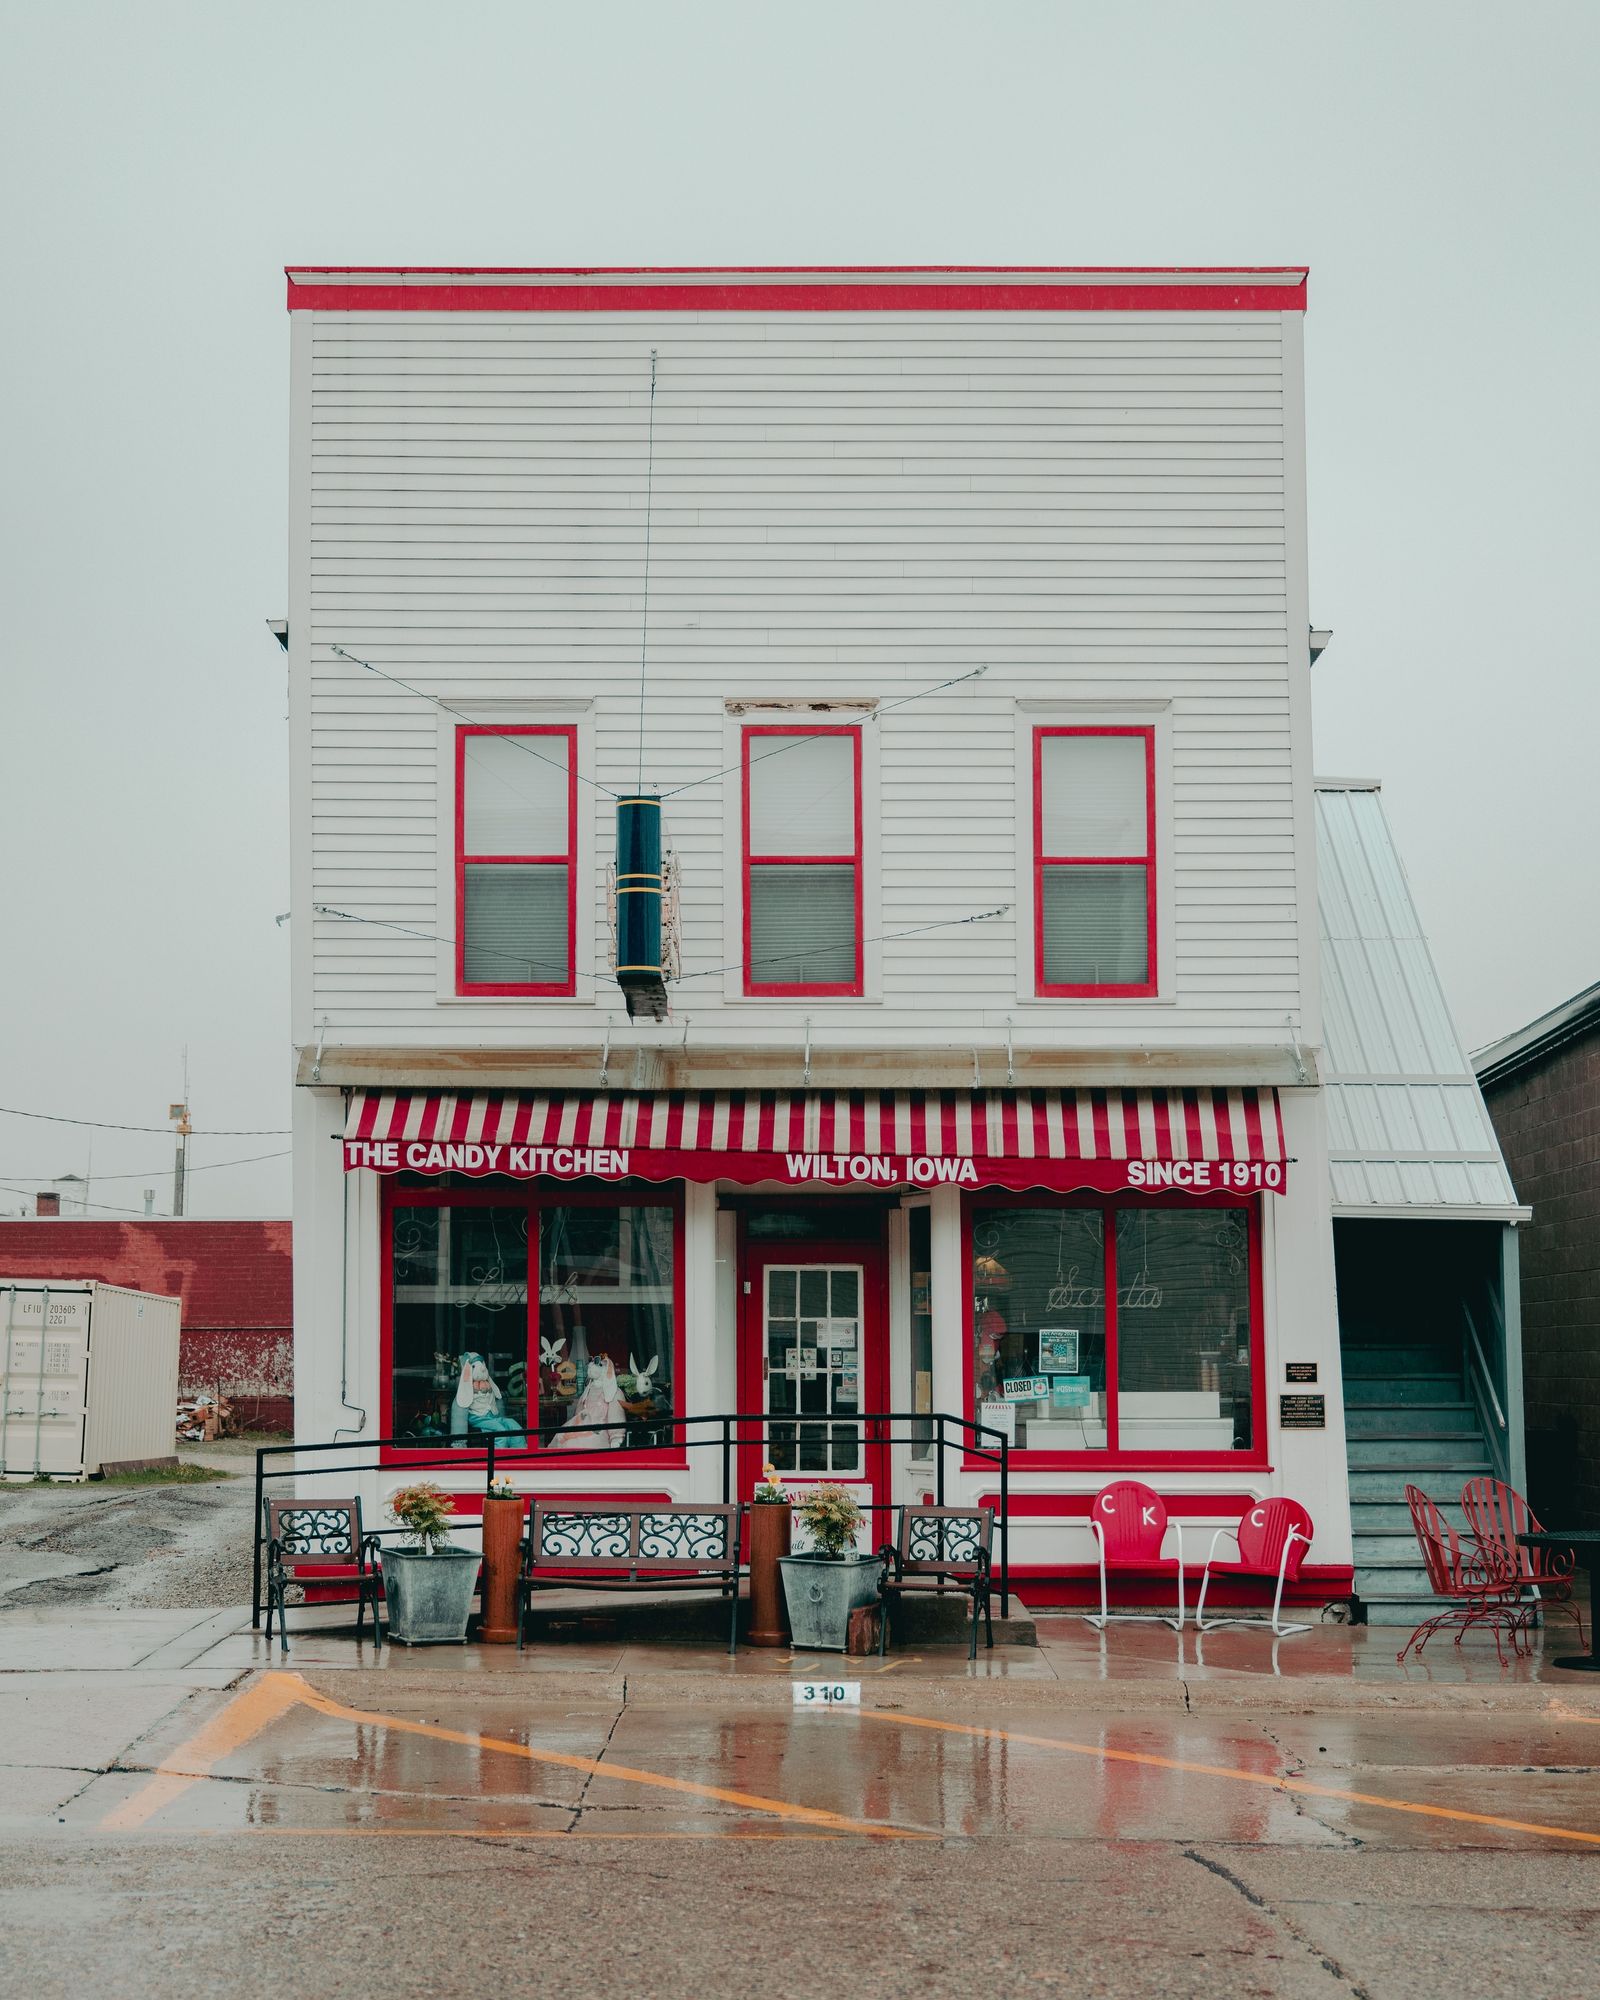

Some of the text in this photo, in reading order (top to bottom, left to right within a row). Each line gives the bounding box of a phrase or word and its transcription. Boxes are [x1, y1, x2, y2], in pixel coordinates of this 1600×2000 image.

[345, 1142, 629, 1174] THE CANDY KITCHEN
[785, 1154, 979, 1182] WILTON, IOWA
[1127, 1160, 1281, 1187] SINCE 1910
[49, 1304, 76, 1315] 203605
[1005, 1380, 1032, 1394] CLOSED
[1101, 1494, 1158, 1526] C K
[1250, 1508, 1302, 1541] C K
[803, 1686, 845, 1701] 310
